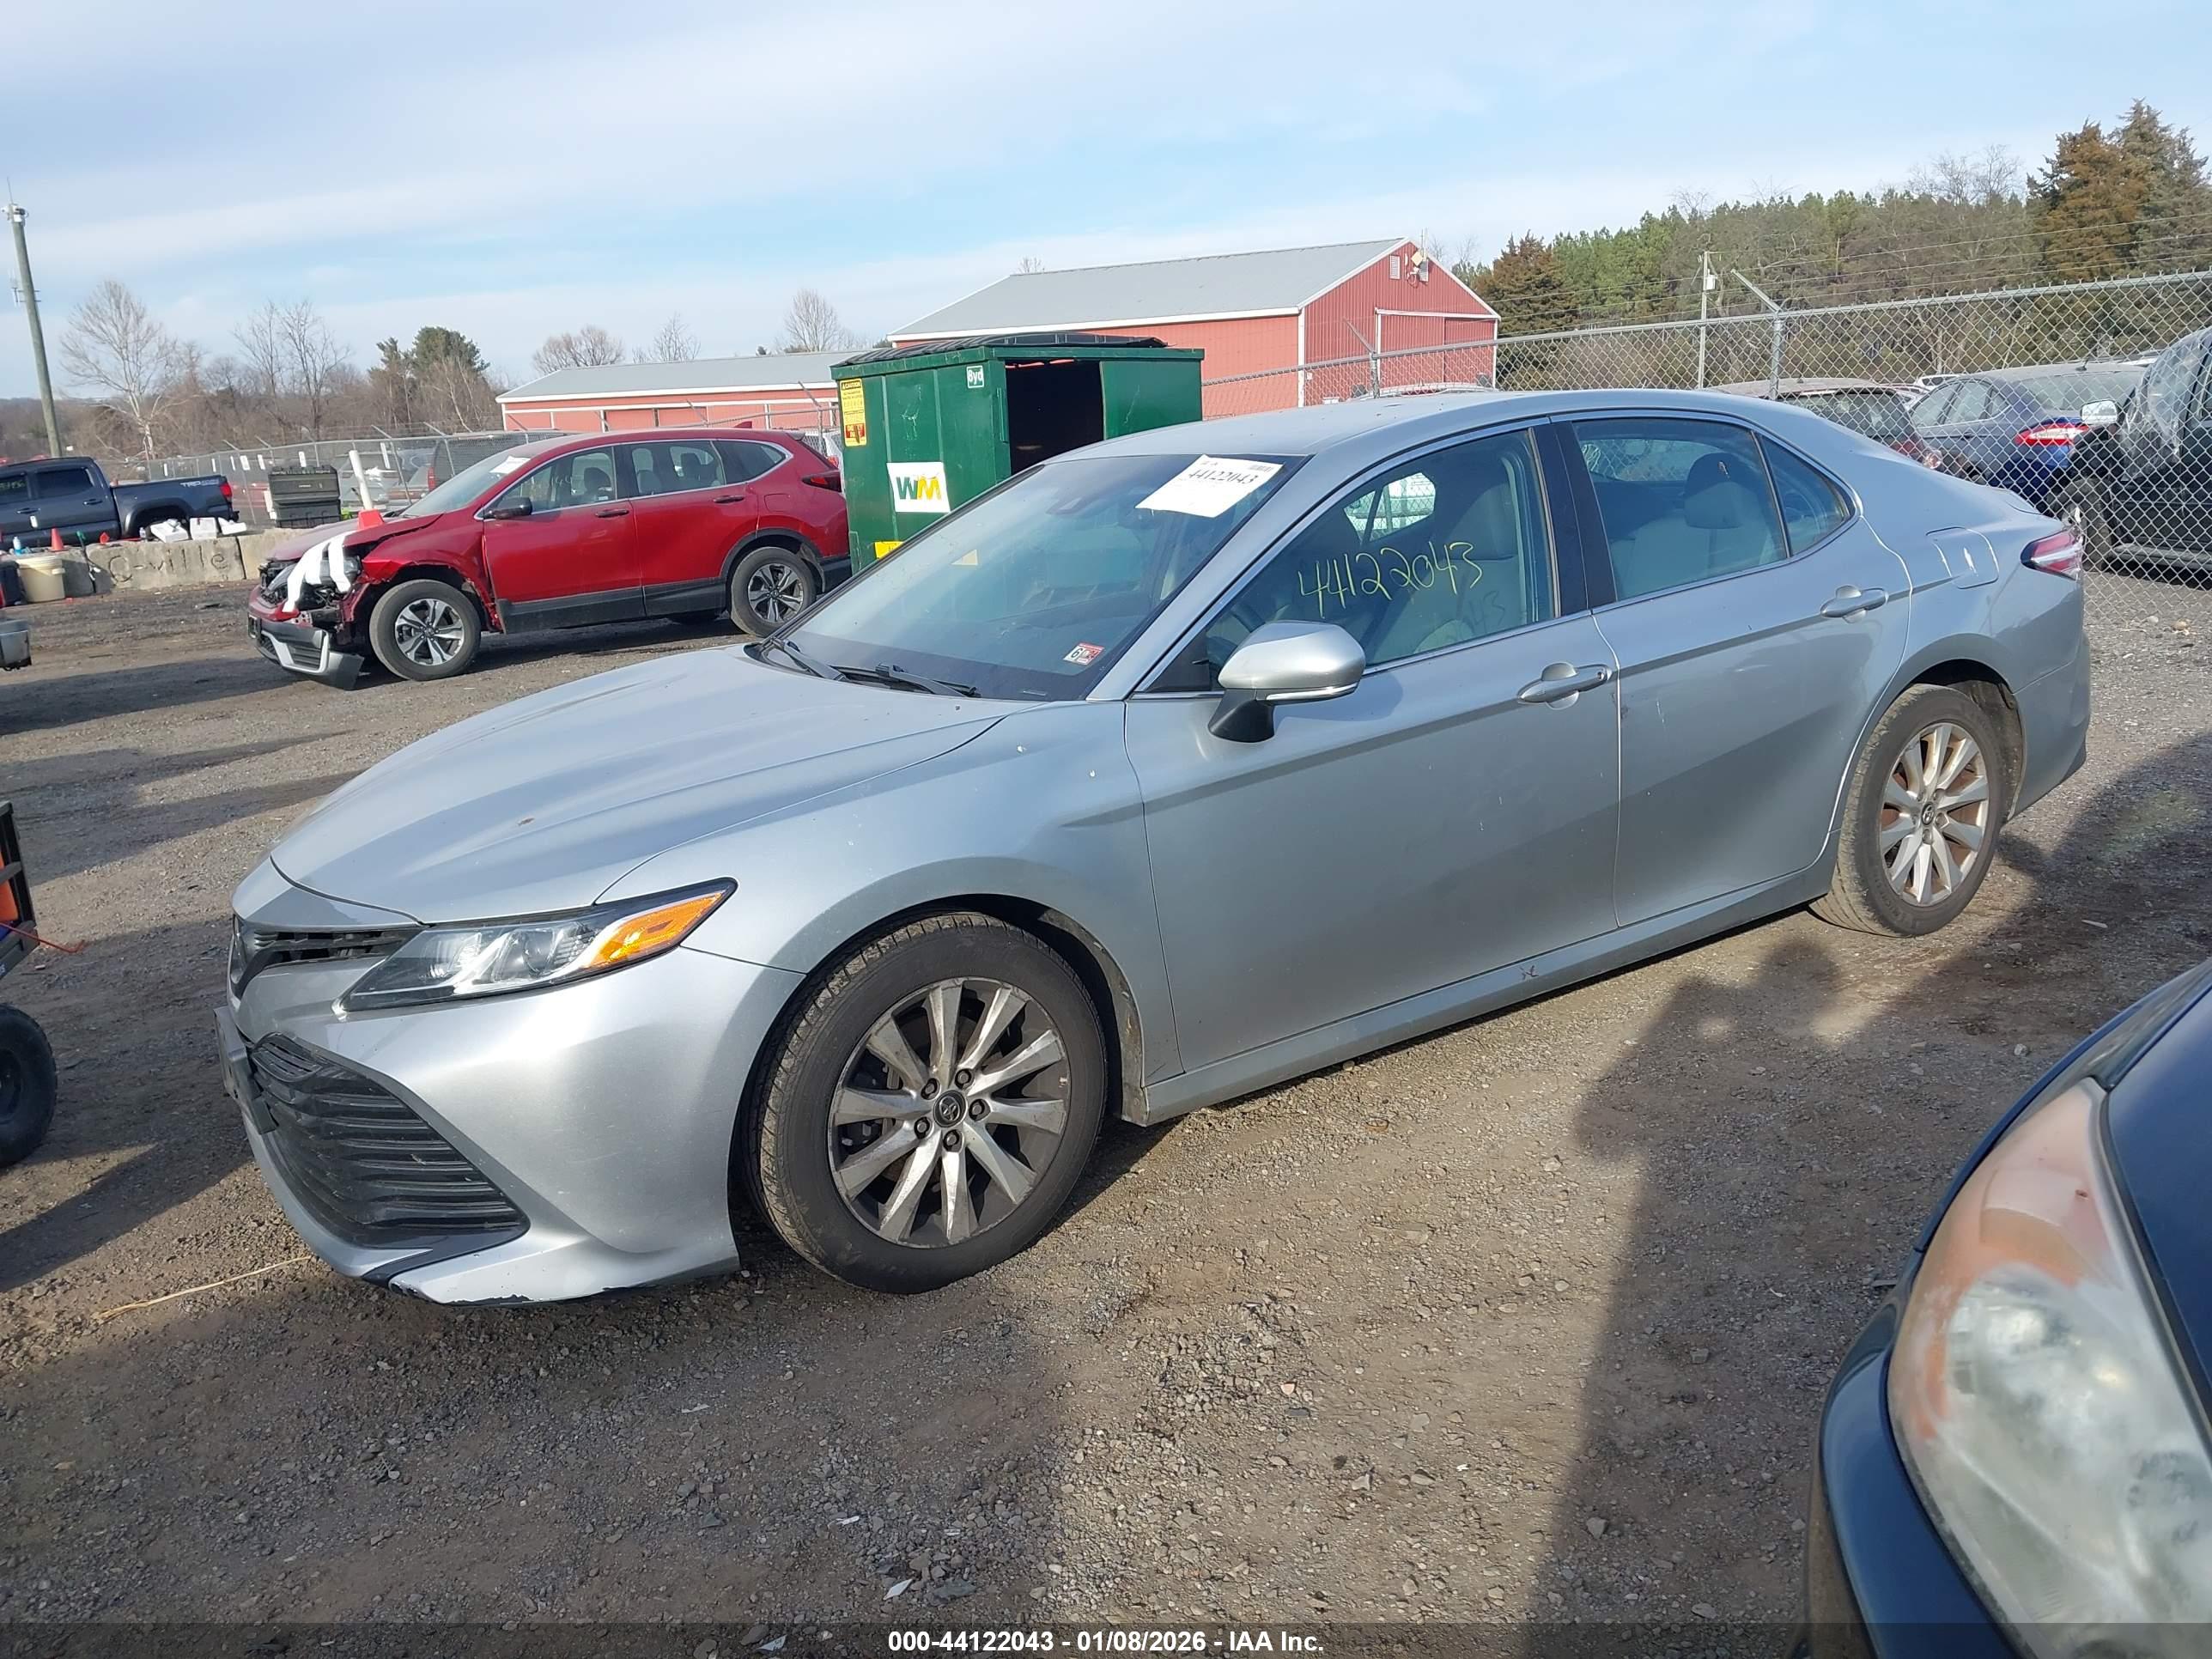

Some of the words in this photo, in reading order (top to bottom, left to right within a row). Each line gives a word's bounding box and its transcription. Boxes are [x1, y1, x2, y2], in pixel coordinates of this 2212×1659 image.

[896, 476, 942, 501] WM
[1188, 470, 1259, 484] 44122043
[1297, 541, 1483, 619] 44122043
